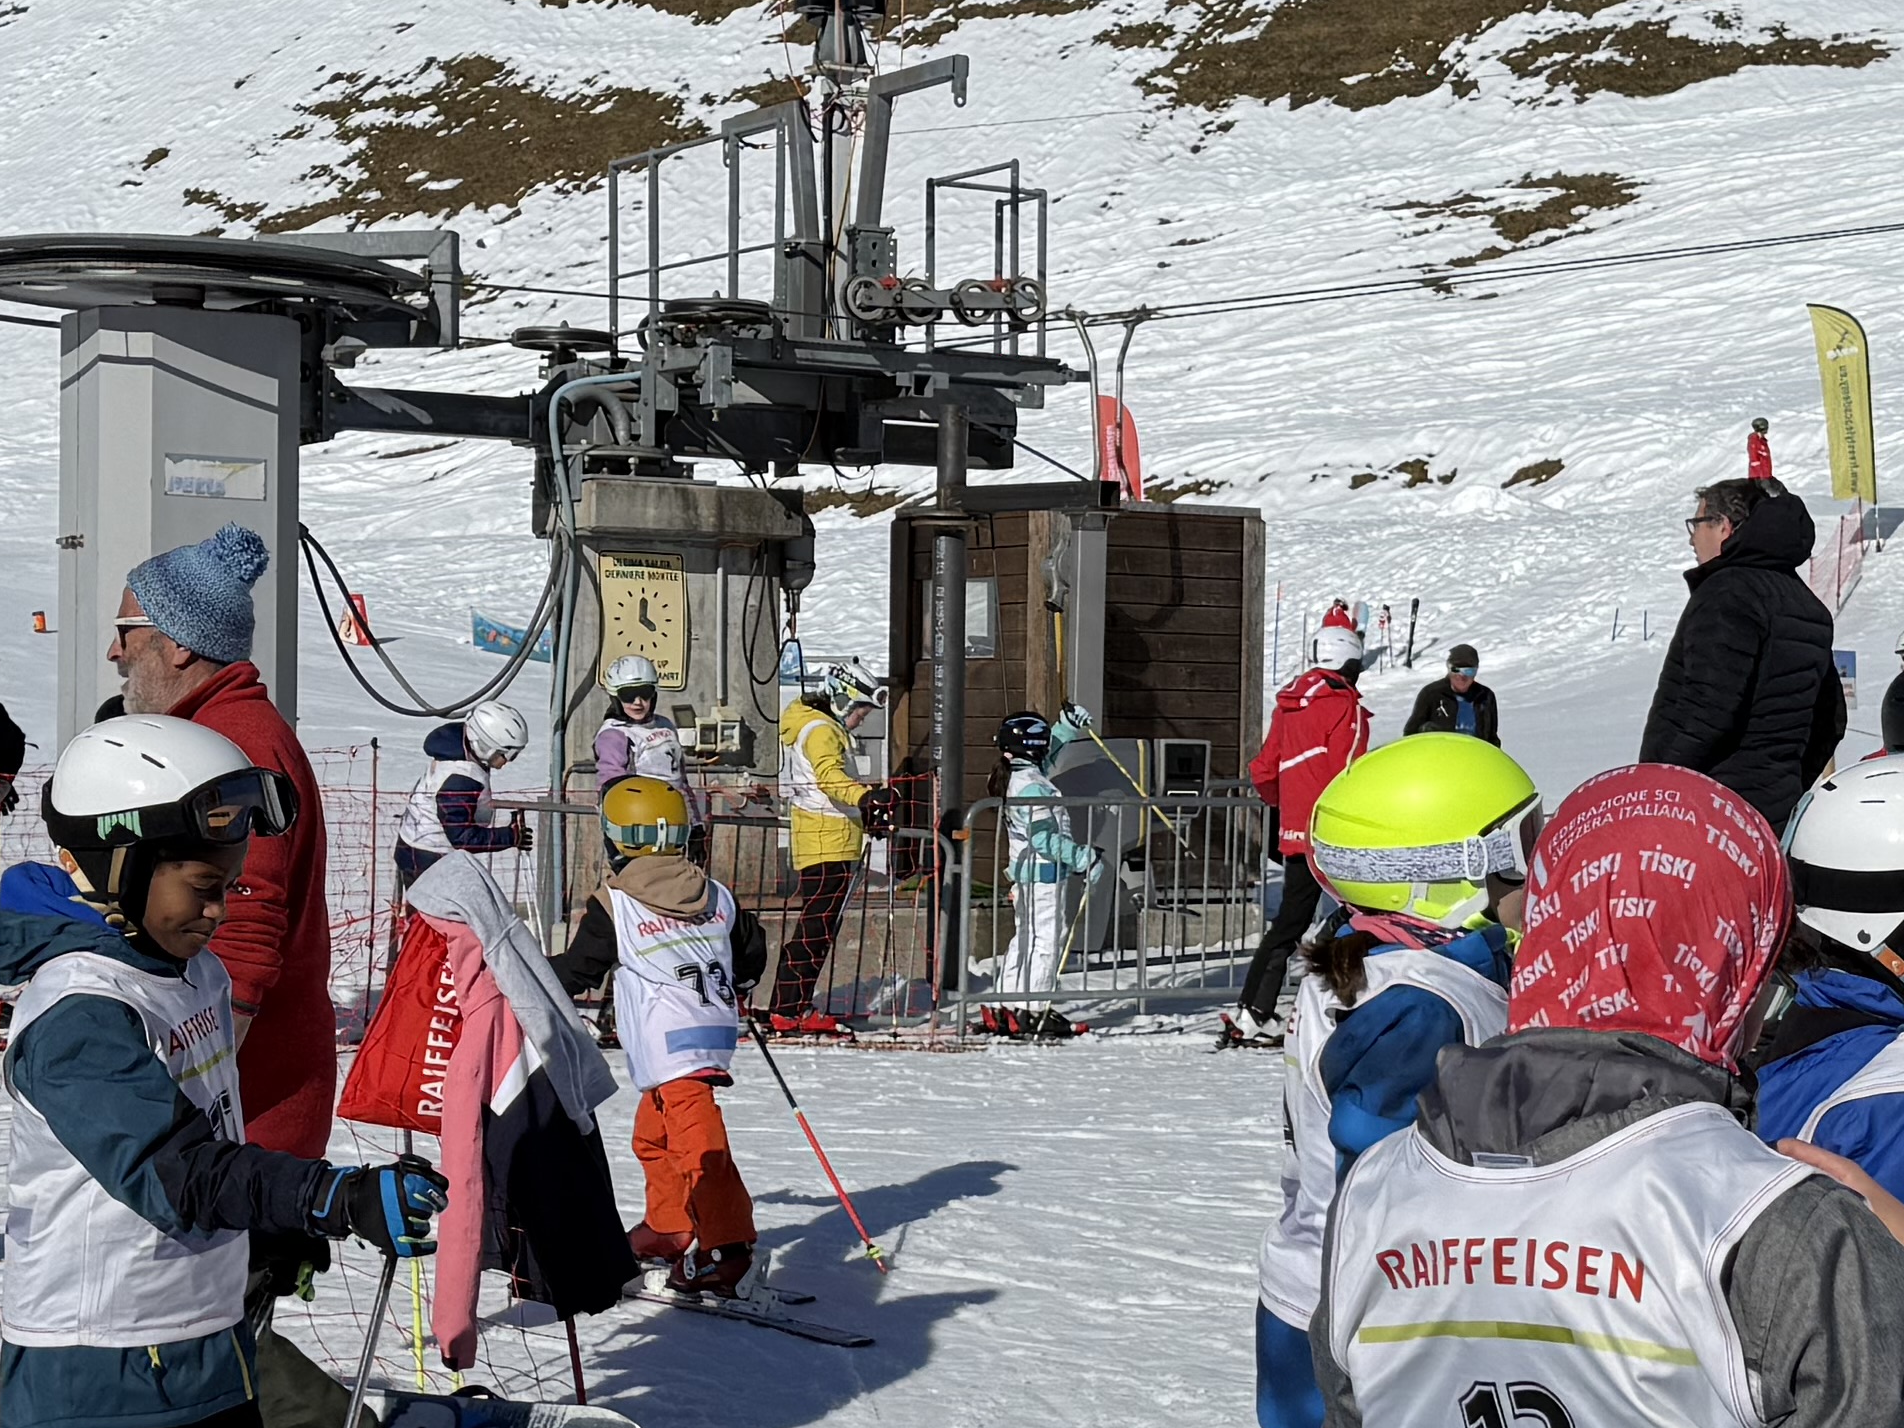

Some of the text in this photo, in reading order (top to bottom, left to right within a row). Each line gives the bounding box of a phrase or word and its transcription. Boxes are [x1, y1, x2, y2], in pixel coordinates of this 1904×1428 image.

[1618, 803, 1698, 825] ITALIANA
[1654, 789, 1681, 803] SCI
[674, 959, 736, 1009] 73
[1376, 1238, 1645, 1303] RAIFFEISEN
